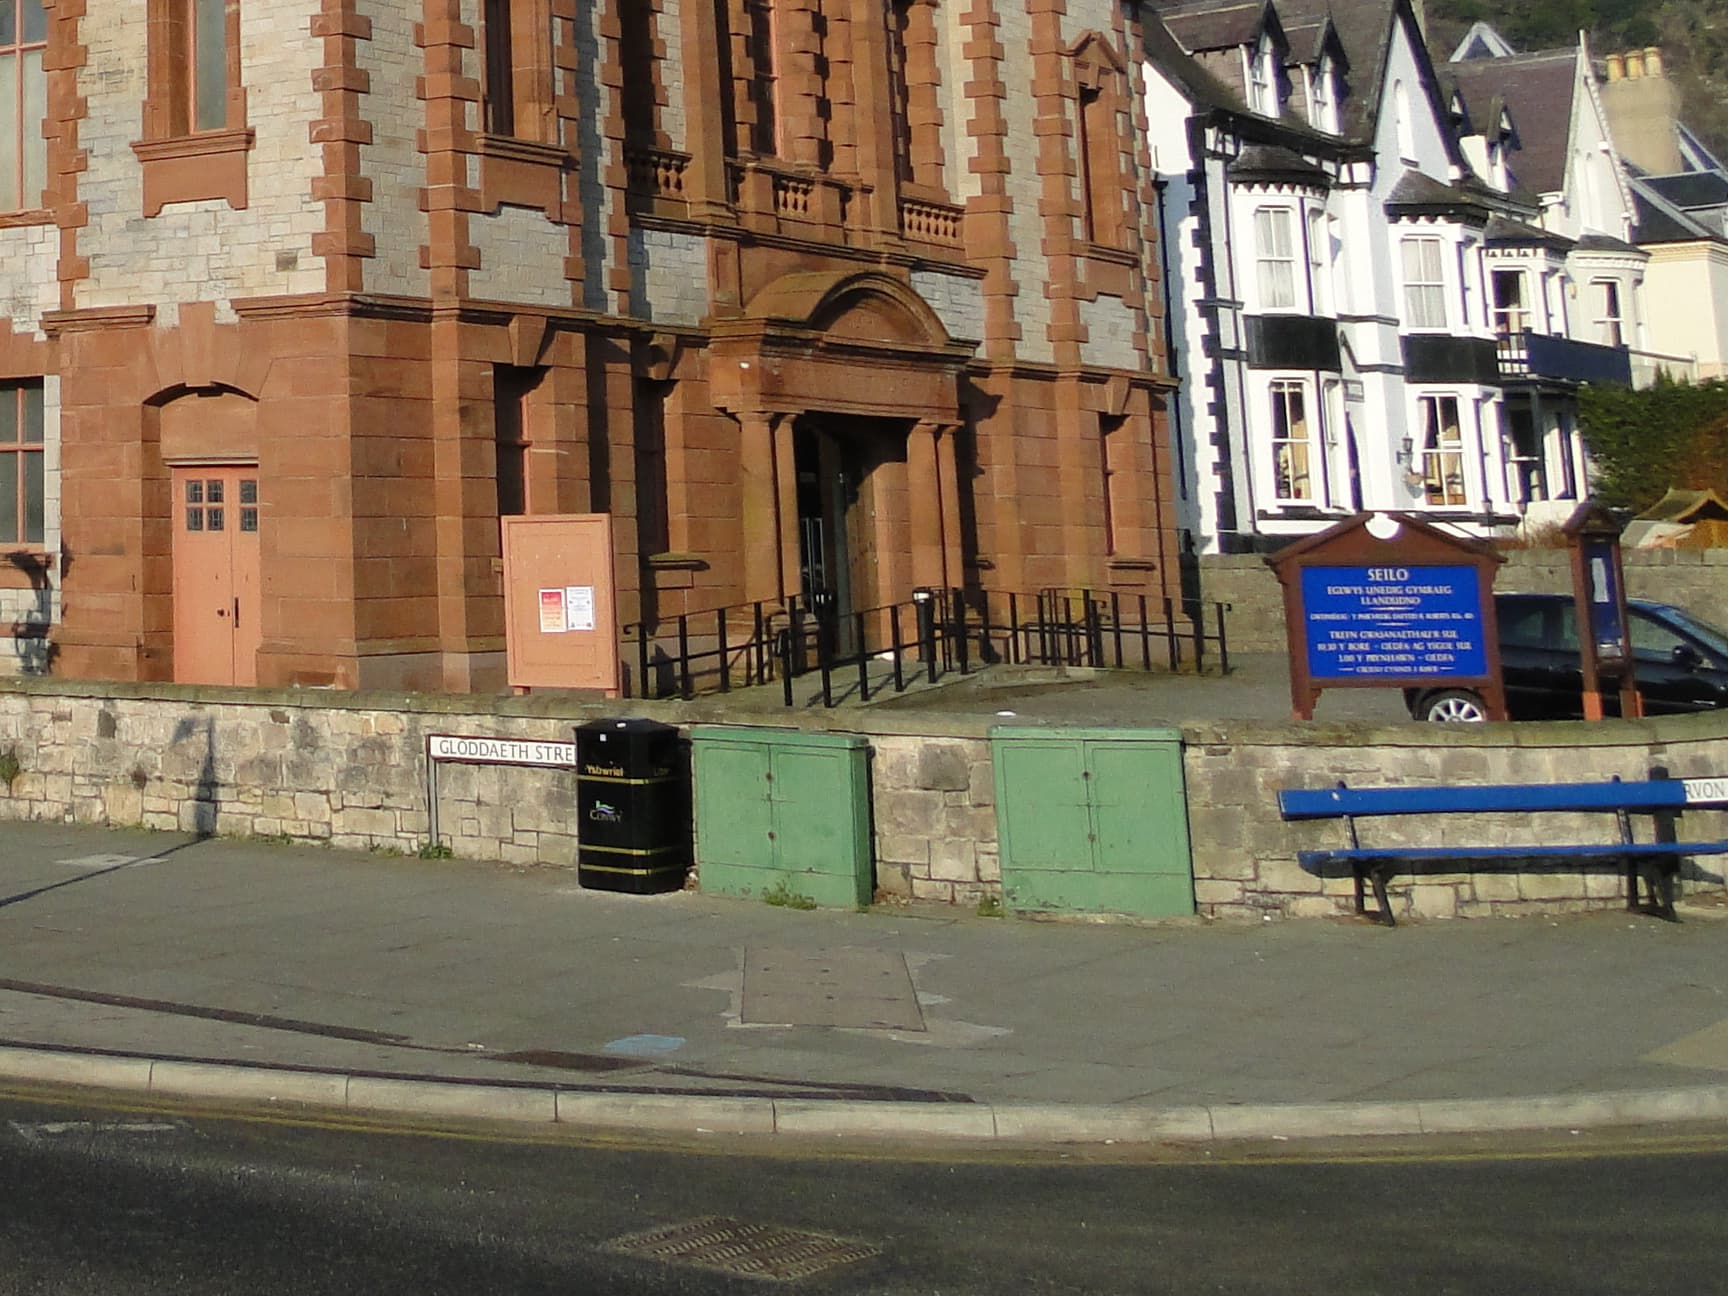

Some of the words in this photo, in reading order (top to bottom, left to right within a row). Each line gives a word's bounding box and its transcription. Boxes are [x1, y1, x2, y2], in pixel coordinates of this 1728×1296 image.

[1367, 568, 1409, 581] SEILO
[1405, 585, 1452, 594] GYMRAEG
[1360, 596, 1421, 605] LLANDUDNO
[439, 740, 529, 760] GLODDAETH
[535, 745, 576, 762] STRE
